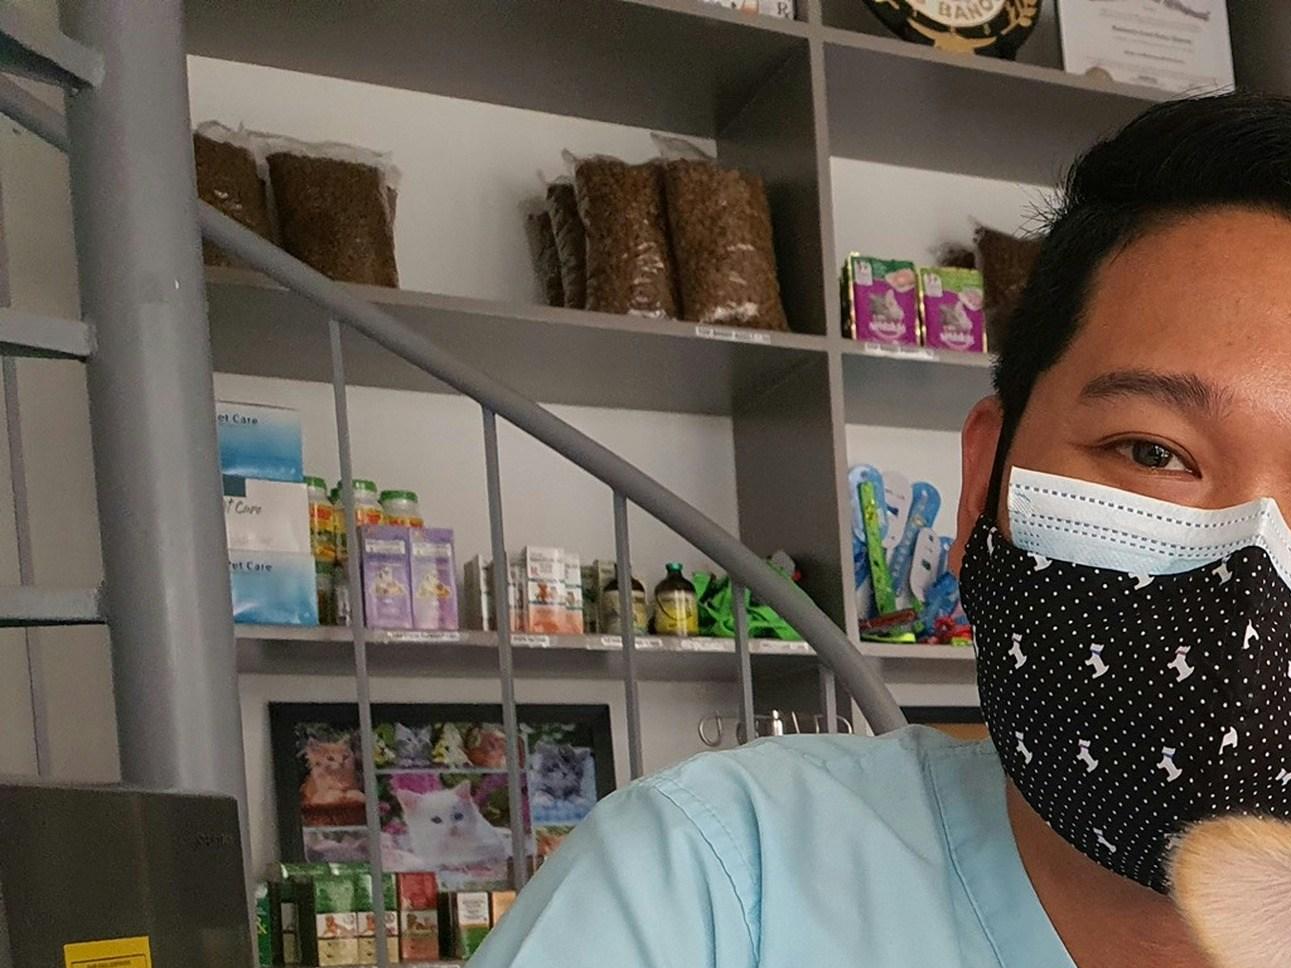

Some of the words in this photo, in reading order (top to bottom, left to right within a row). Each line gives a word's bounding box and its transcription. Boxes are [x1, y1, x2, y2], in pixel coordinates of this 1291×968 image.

[217, 414, 229, 424] et
[232, 413, 259, 425] Care
[246, 561, 273, 572] Care
